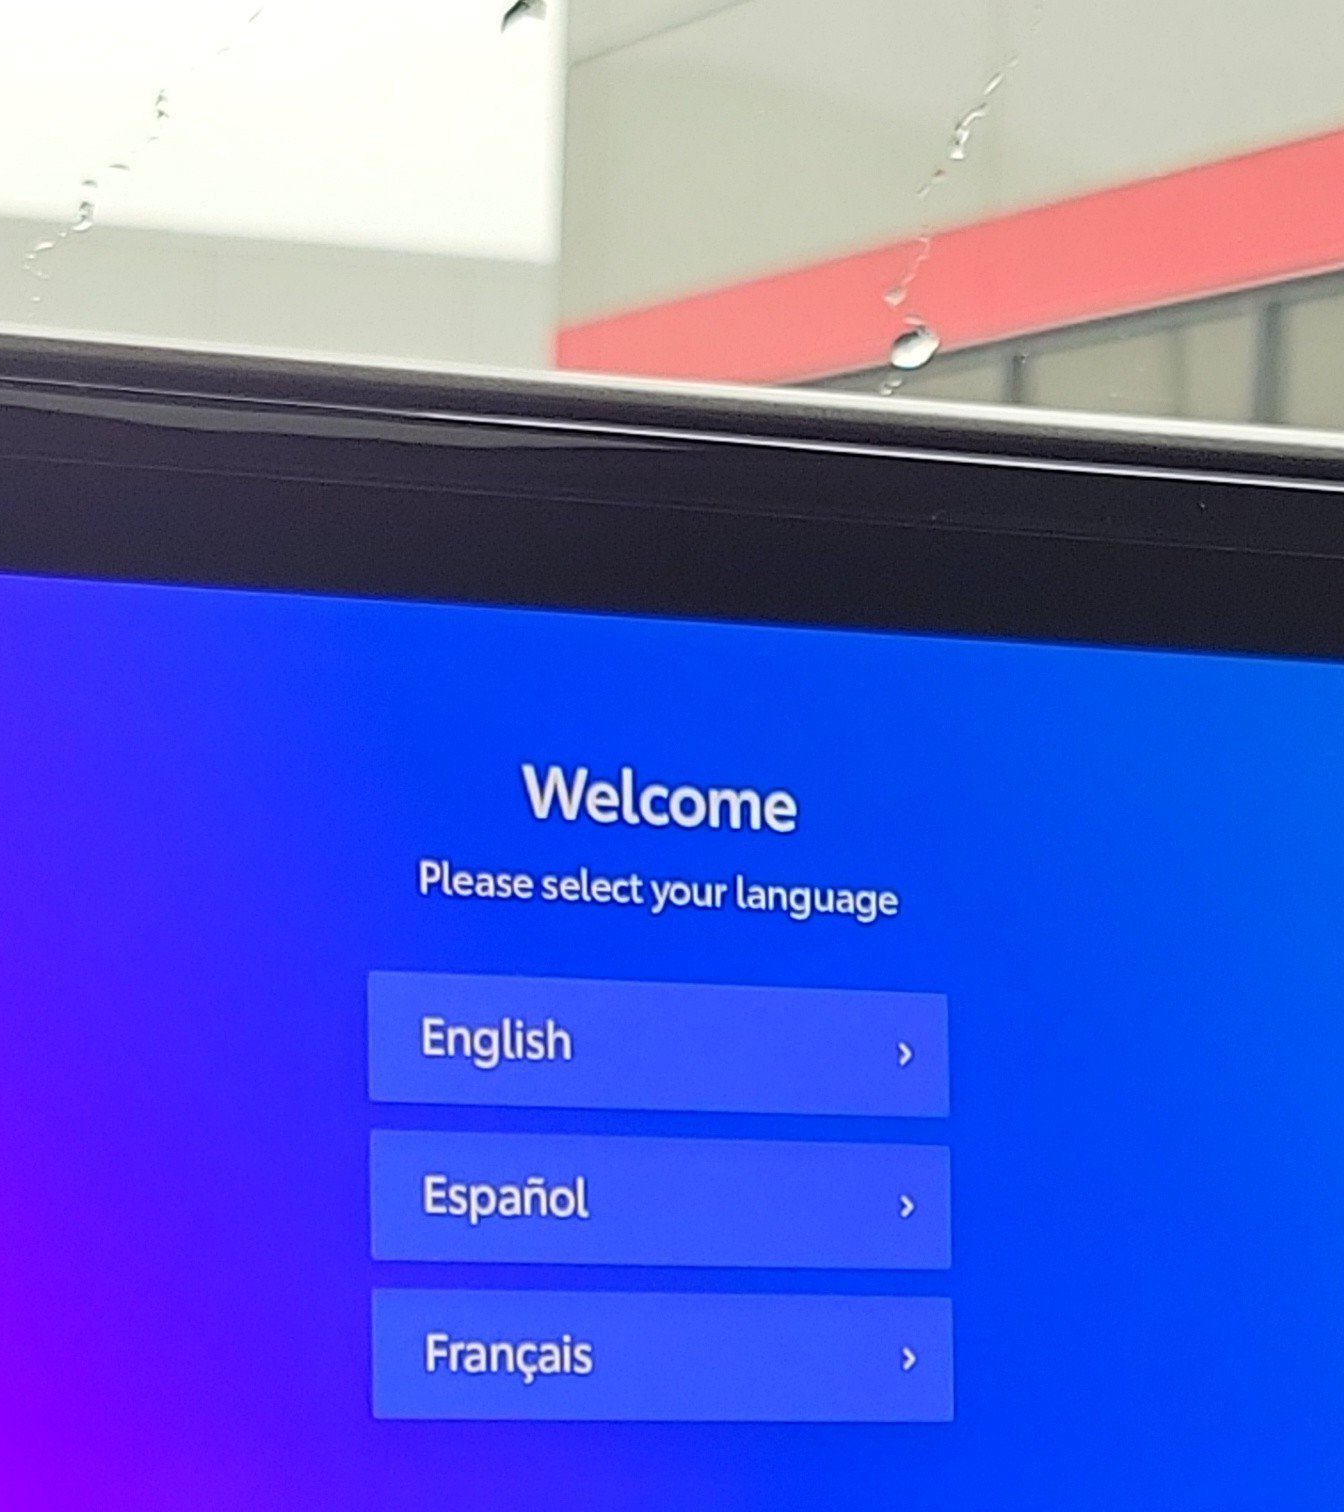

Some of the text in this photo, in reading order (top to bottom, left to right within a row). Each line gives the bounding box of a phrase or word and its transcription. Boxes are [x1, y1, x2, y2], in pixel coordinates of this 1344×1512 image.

[521, 763, 798, 832] Welcome
[419, 860, 900, 923] Please select your language
[421, 1017, 573, 1069] English
[423, 1174, 590, 1224] Español
[425, 1333, 594, 1384] Français
